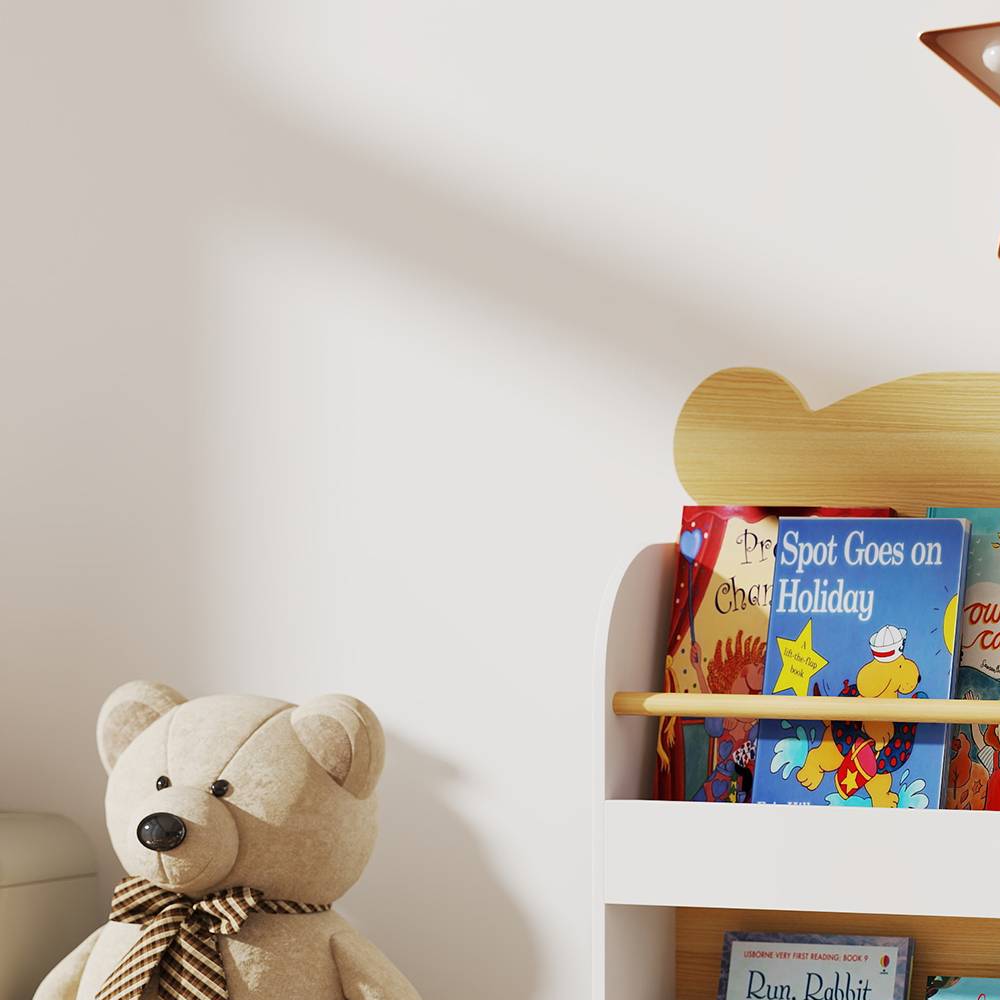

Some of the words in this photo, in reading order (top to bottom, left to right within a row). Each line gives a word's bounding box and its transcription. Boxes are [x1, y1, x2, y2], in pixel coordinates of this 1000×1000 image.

[780, 530, 838, 573] Spot
[843, 530, 905, 566] Goes
[910, 541, 943, 566] on
[775, 578, 875, 622] Holiday
[783, 647, 818, 669] lift-the-flap
[790, 665, 805, 678] book
[743, 951, 773, 959] USBORNE
[775, 952, 790, 960] VERY
[792, 952, 808, 960] FIRST
[843, 954, 862, 962] BOOK
